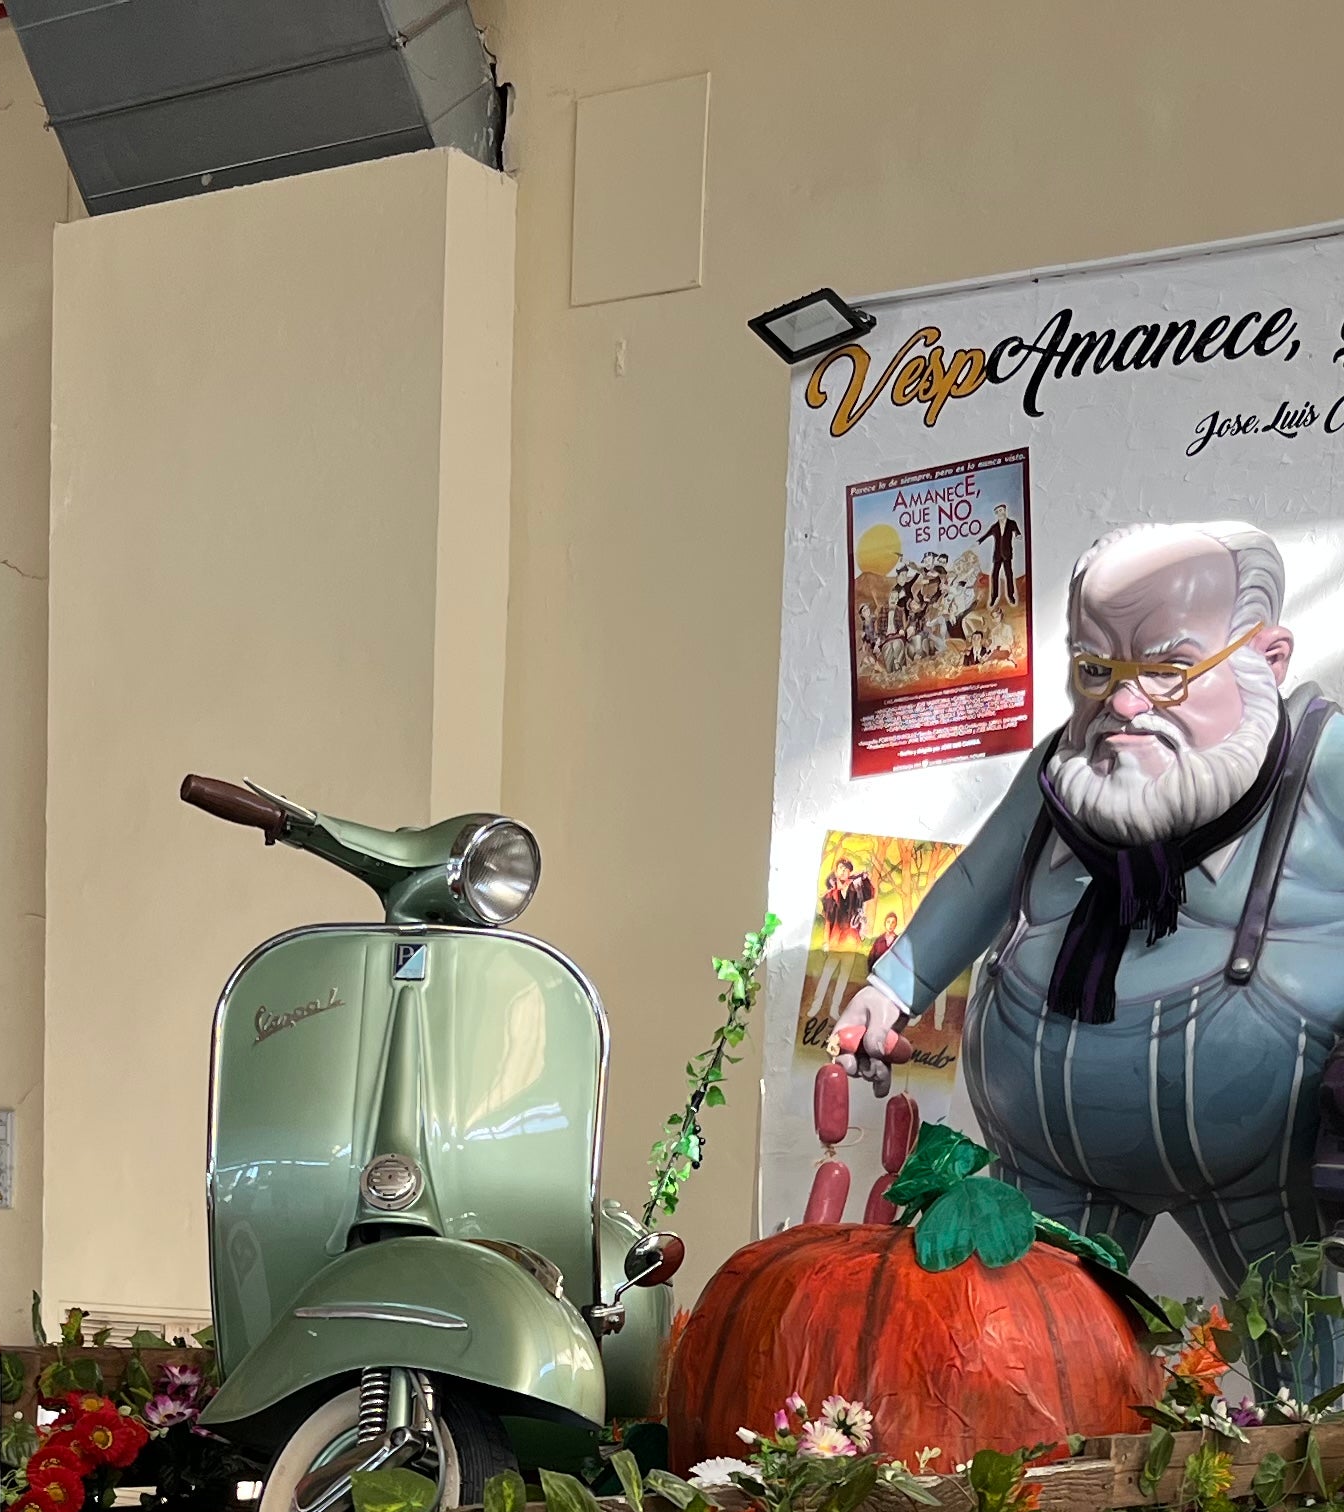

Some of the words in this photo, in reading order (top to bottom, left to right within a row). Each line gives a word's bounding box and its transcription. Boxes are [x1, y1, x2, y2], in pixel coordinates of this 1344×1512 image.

[1261, 401, 1320, 439] Luis
[892, 475, 981, 512] AMANECE,
[898, 507, 931, 528] QUE
[937, 499, 972, 525] NO
[915, 526, 931, 544] ES
[938, 519, 982, 542] POCO
